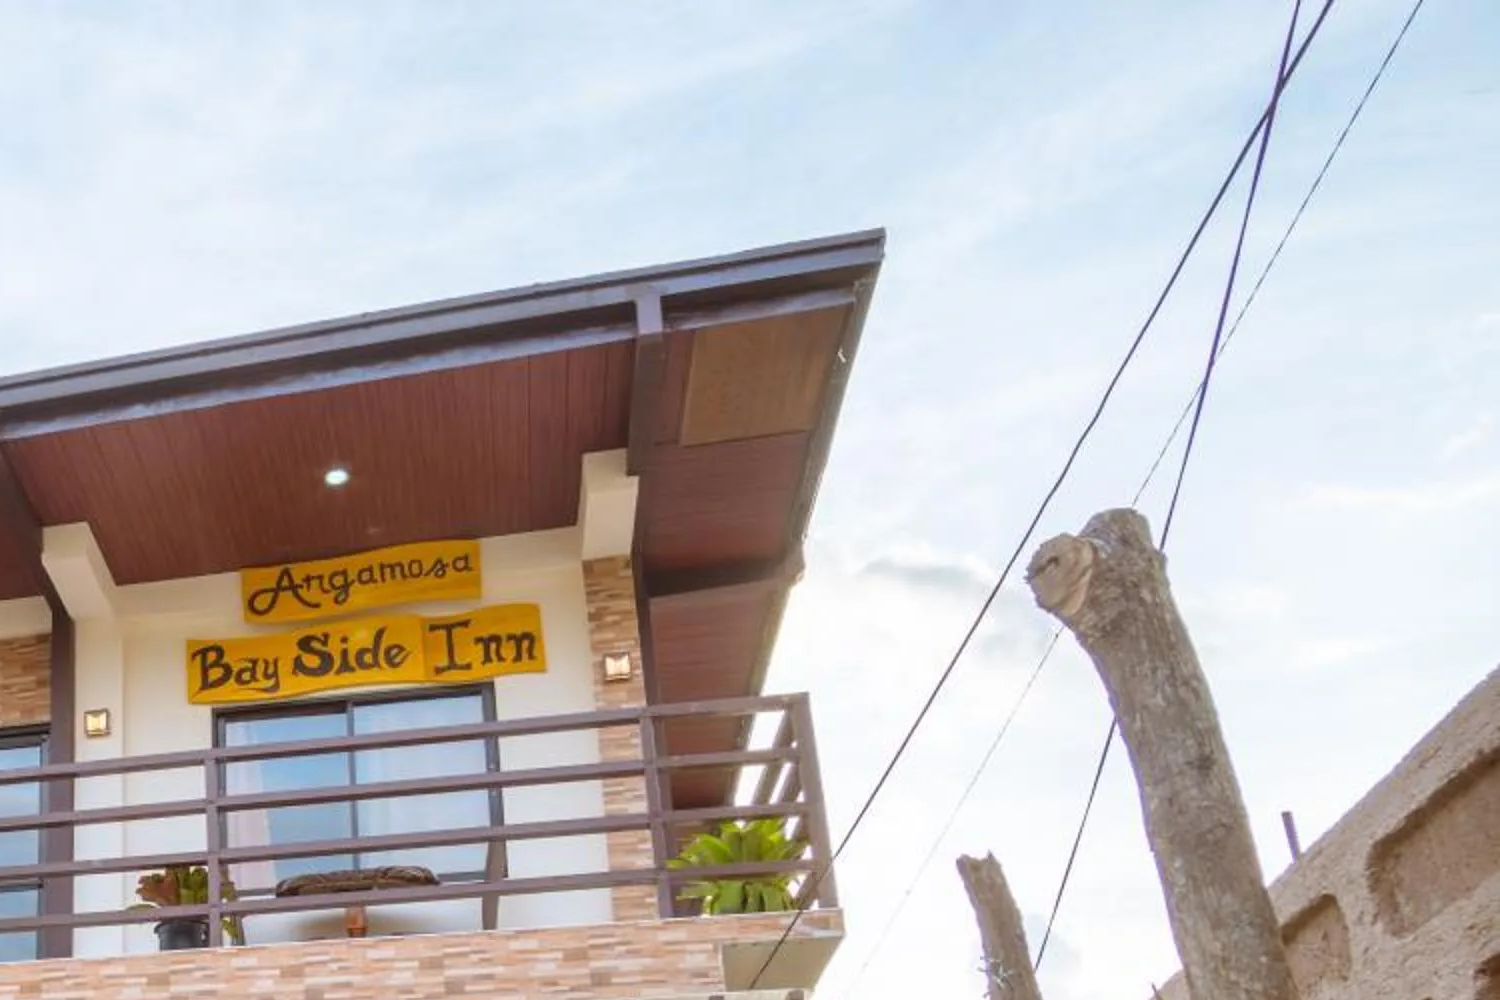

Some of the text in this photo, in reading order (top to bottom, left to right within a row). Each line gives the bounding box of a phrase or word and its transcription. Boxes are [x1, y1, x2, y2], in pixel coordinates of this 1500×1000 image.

[247, 553, 473, 616] Angamosa
[191, 619, 537, 694] Bay Side Inn
